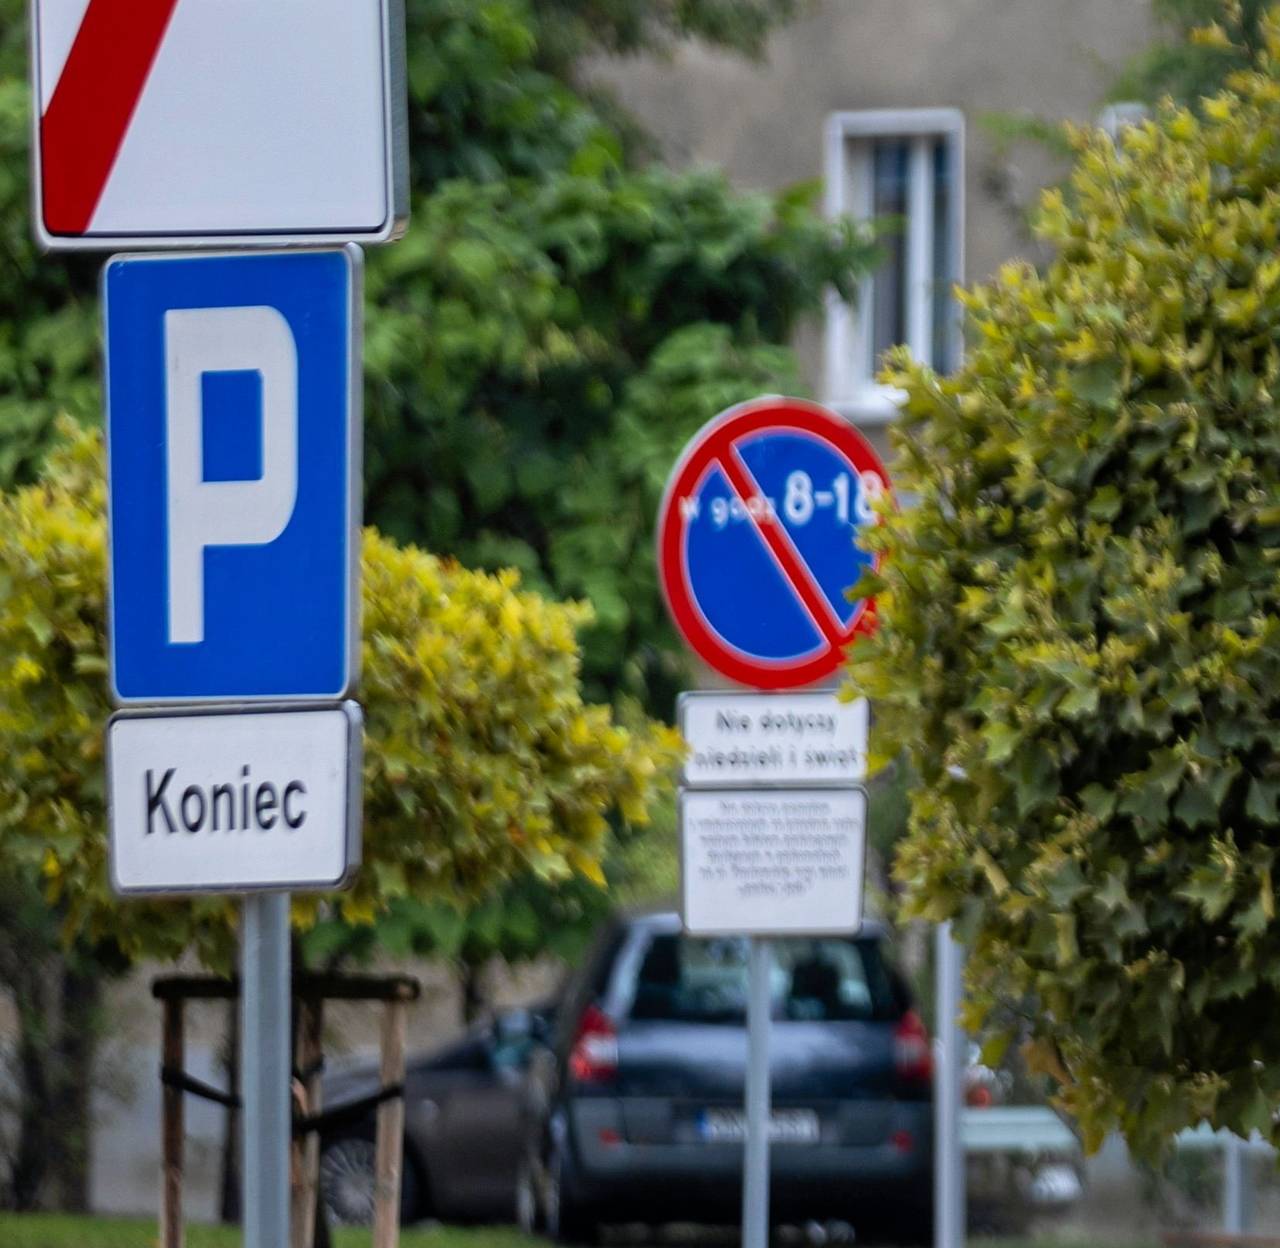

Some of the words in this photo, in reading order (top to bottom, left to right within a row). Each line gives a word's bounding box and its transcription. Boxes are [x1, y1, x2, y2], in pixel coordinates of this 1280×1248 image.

[164, 305, 299, 646] P
[716, 709, 752, 733] Nie
[145, 764, 308, 835] Koniec
